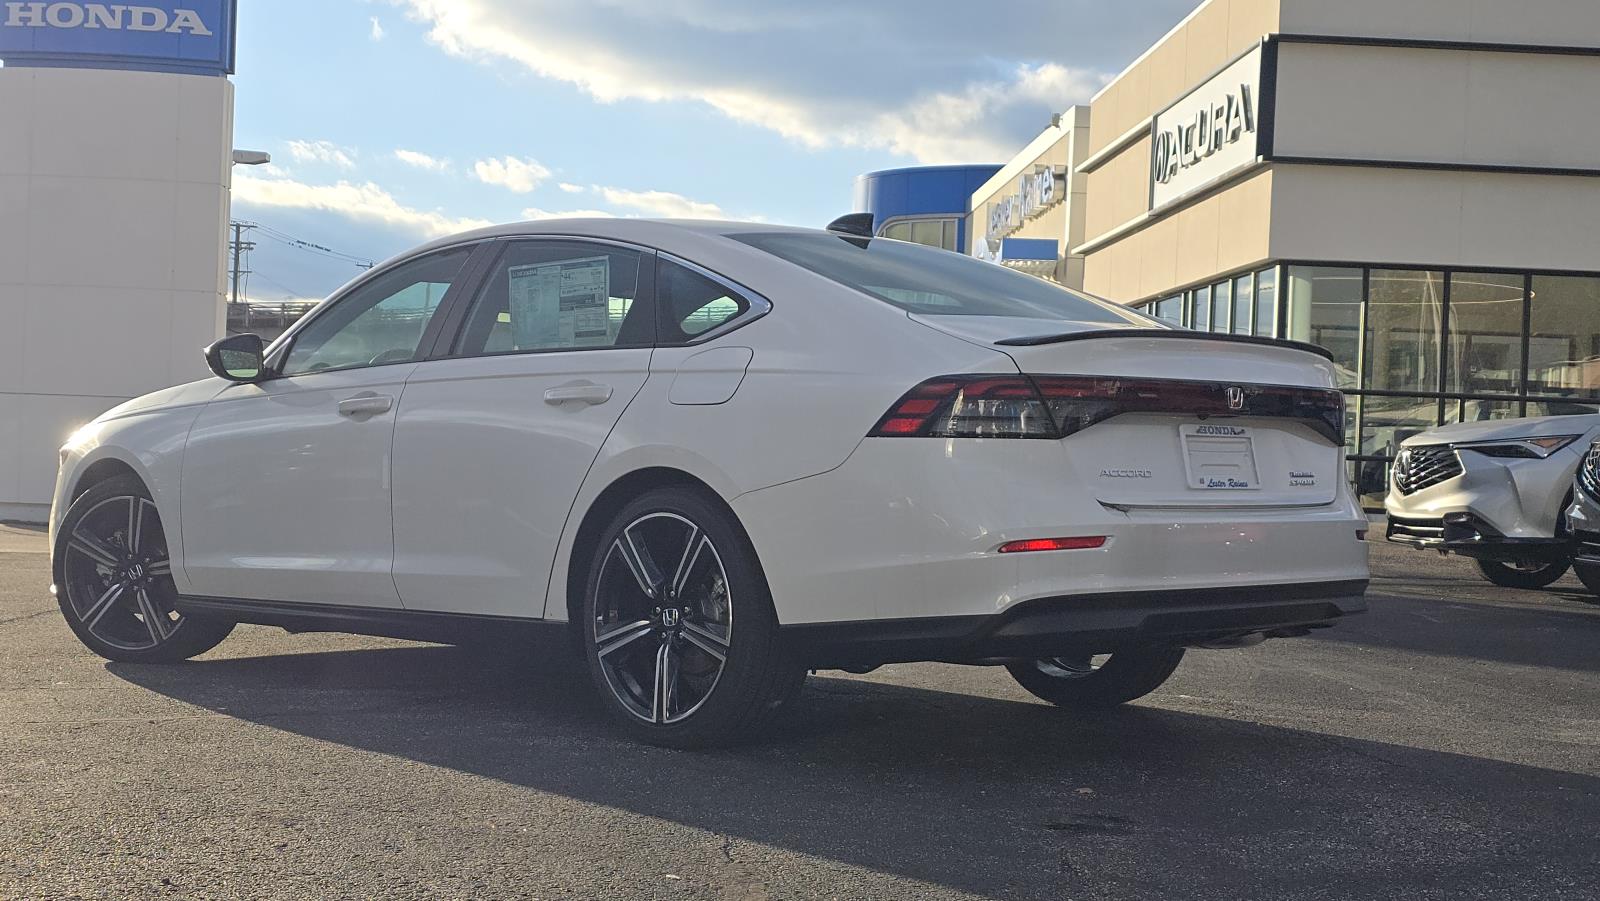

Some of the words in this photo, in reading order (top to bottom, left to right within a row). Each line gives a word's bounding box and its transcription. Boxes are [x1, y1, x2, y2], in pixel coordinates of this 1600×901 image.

[4, 2, 213, 36] HONDA
[1165, 83, 1255, 177] ACURA
[1198, 425, 1237, 435] HONDA
[1099, 469, 1152, 478] ACCORD
[1207, 478, 1227, 488] Lester
